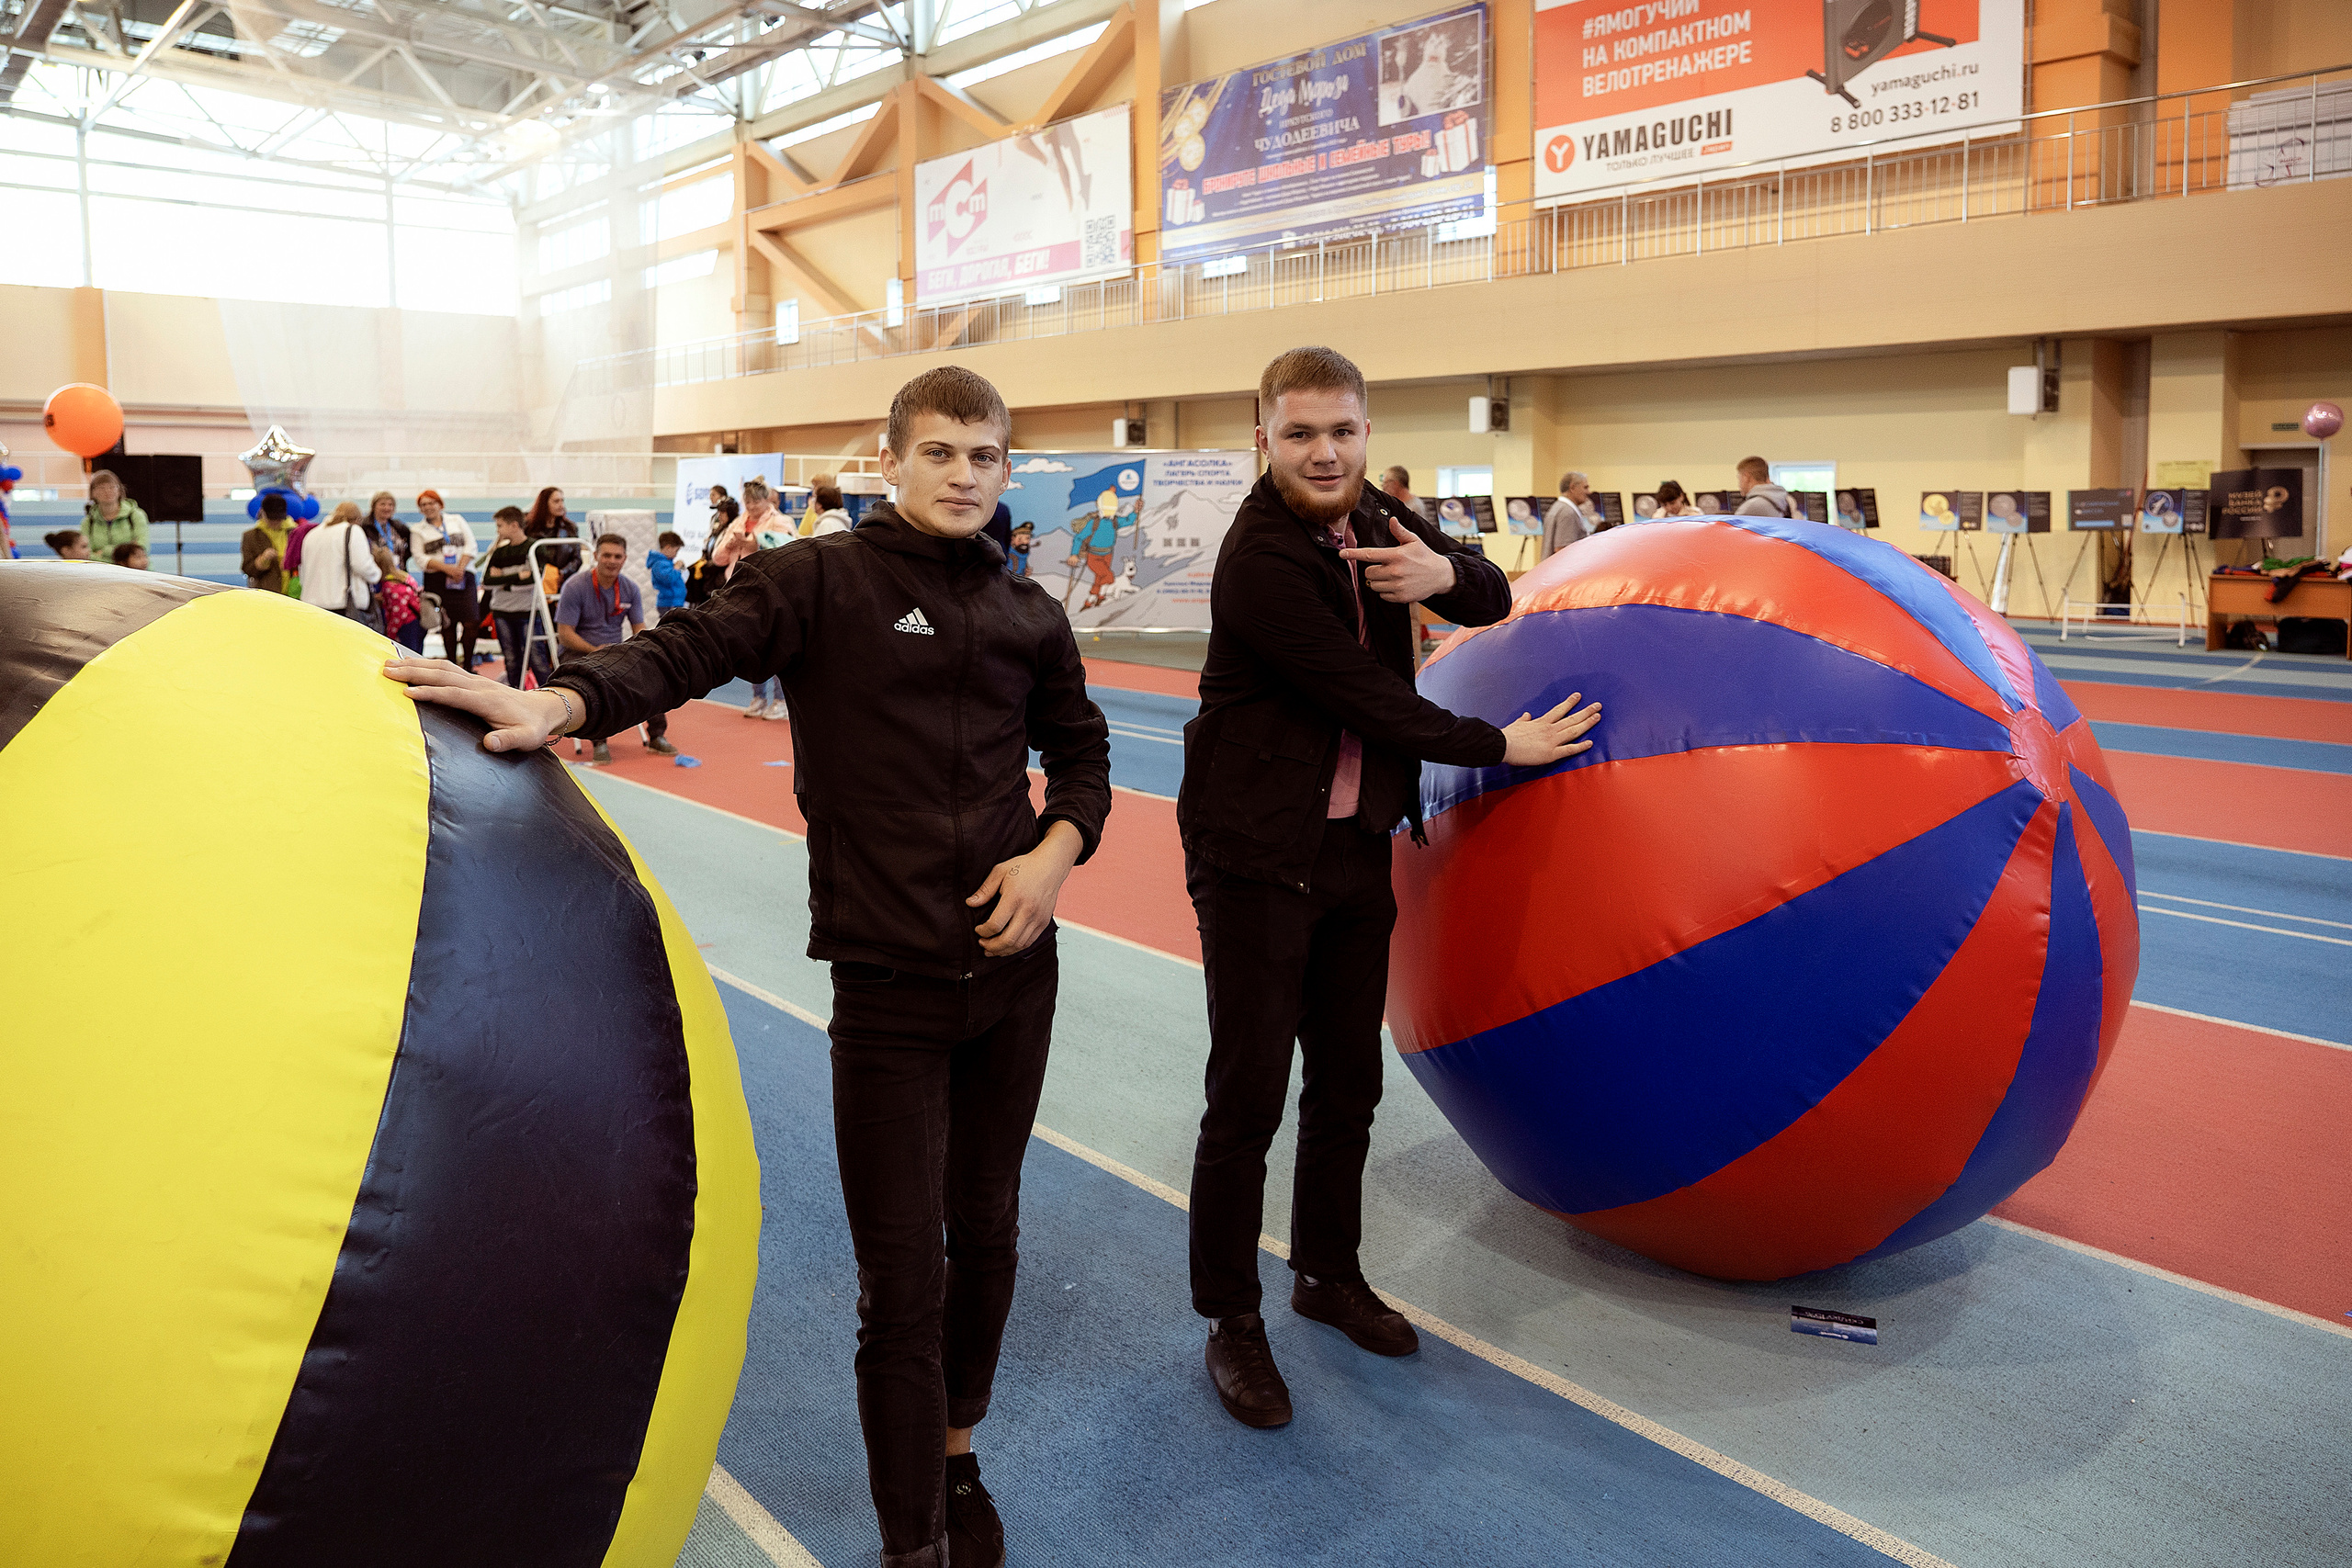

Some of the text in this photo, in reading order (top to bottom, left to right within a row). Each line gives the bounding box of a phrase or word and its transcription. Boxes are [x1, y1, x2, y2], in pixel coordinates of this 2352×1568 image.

[1582, 9, 1751, 69] НА КОМПАКТНОМ
[1252, 42, 1367, 86] ГОСТЕВОЙ ДОМ
[1582, 40, 1752, 97] ВЕЛОТРЕНАЖЕРЕ
[1871, 63, 1979, 96] yamaguchi.ru
[1254, 116, 1360, 152] ЧУДОДЕЕВИЧА
[1583, 108, 1732, 161] YAMAGUCHI
[1831, 117, 1841, 132] 8
[1849, 108, 1883, 130] 800
[1606, 156, 1647, 171] ТОЛЬКО
[1650, 148, 1694, 164] ЛУЧШЕЕ
[893, 622, 934, 636] adidas
